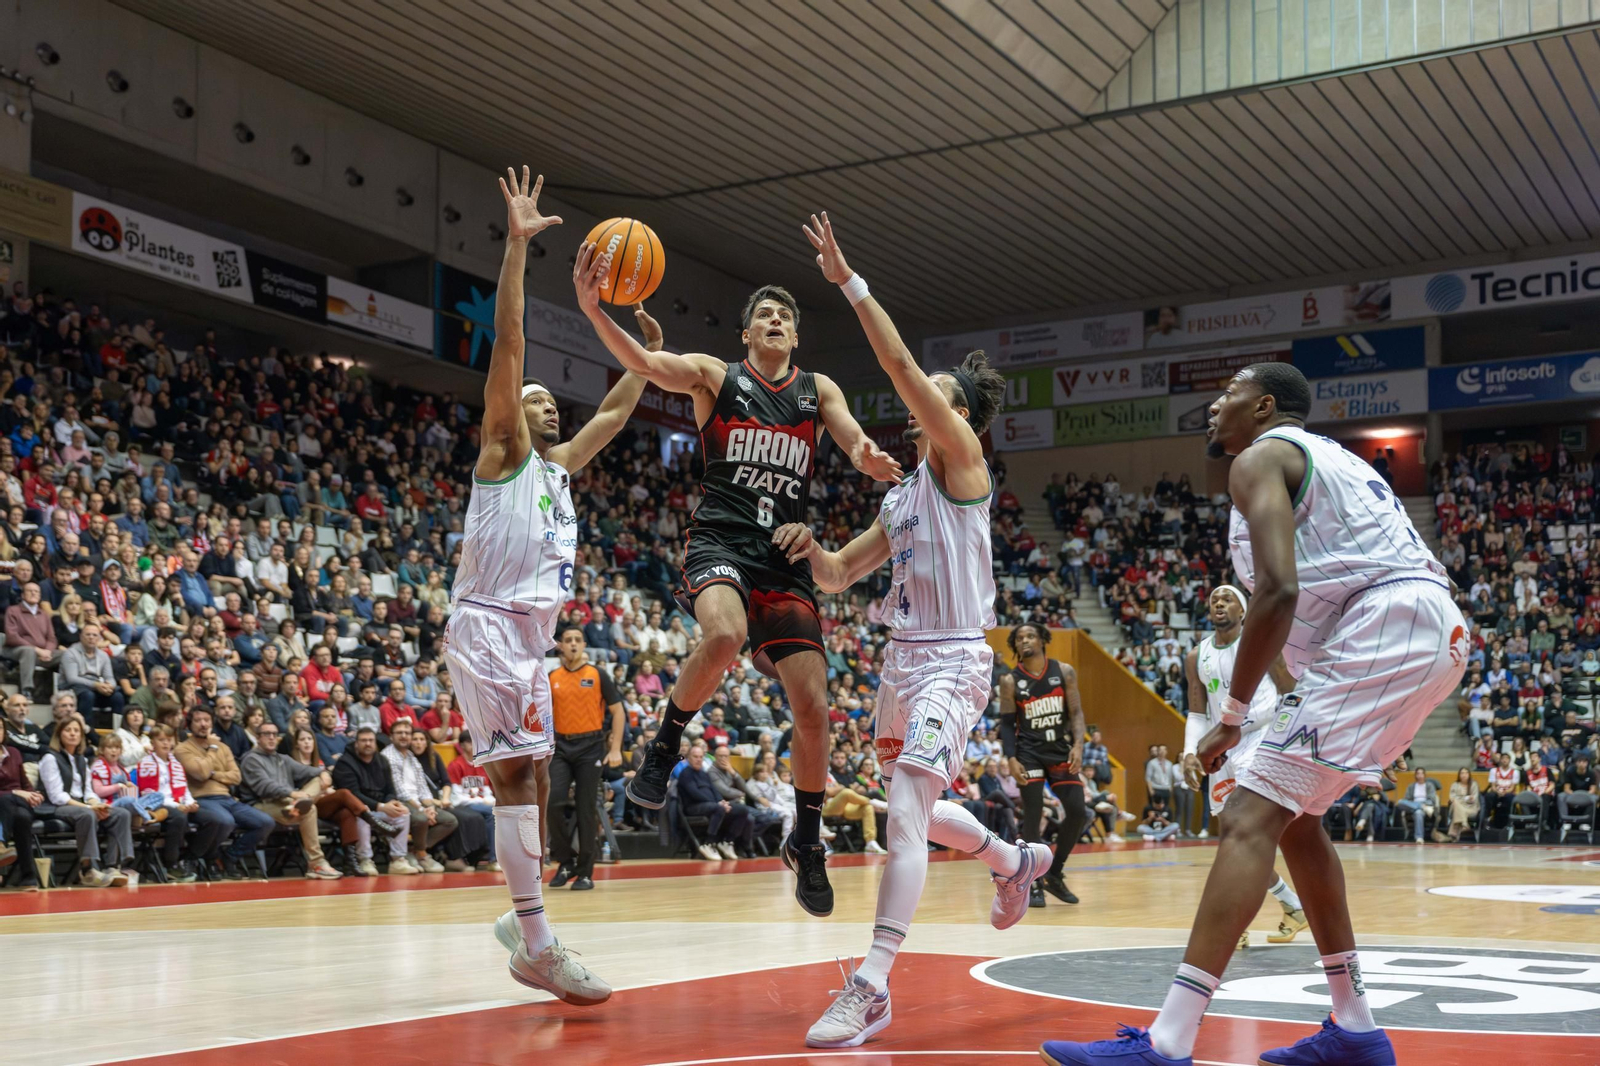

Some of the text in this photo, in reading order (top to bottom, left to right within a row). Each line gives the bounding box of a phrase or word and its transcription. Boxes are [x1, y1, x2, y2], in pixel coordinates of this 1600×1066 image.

[124, 230, 195, 268] Plantes
[633, 244, 644, 280] endesa
[1188, 312, 1261, 333] FRISELVA
[1485, 362, 1556, 384] infosoft
[1316, 379, 1388, 400] Estanys
[1056, 409, 1097, 430] Prat
[1348, 399, 1400, 418] Blaus
[1005, 417, 1015, 441] 5
[731, 464, 802, 500] FIATC
[757, 496, 774, 527] 6
[1031, 714, 1062, 729] FIATC
[1347, 961, 1365, 998] UNICAJA
